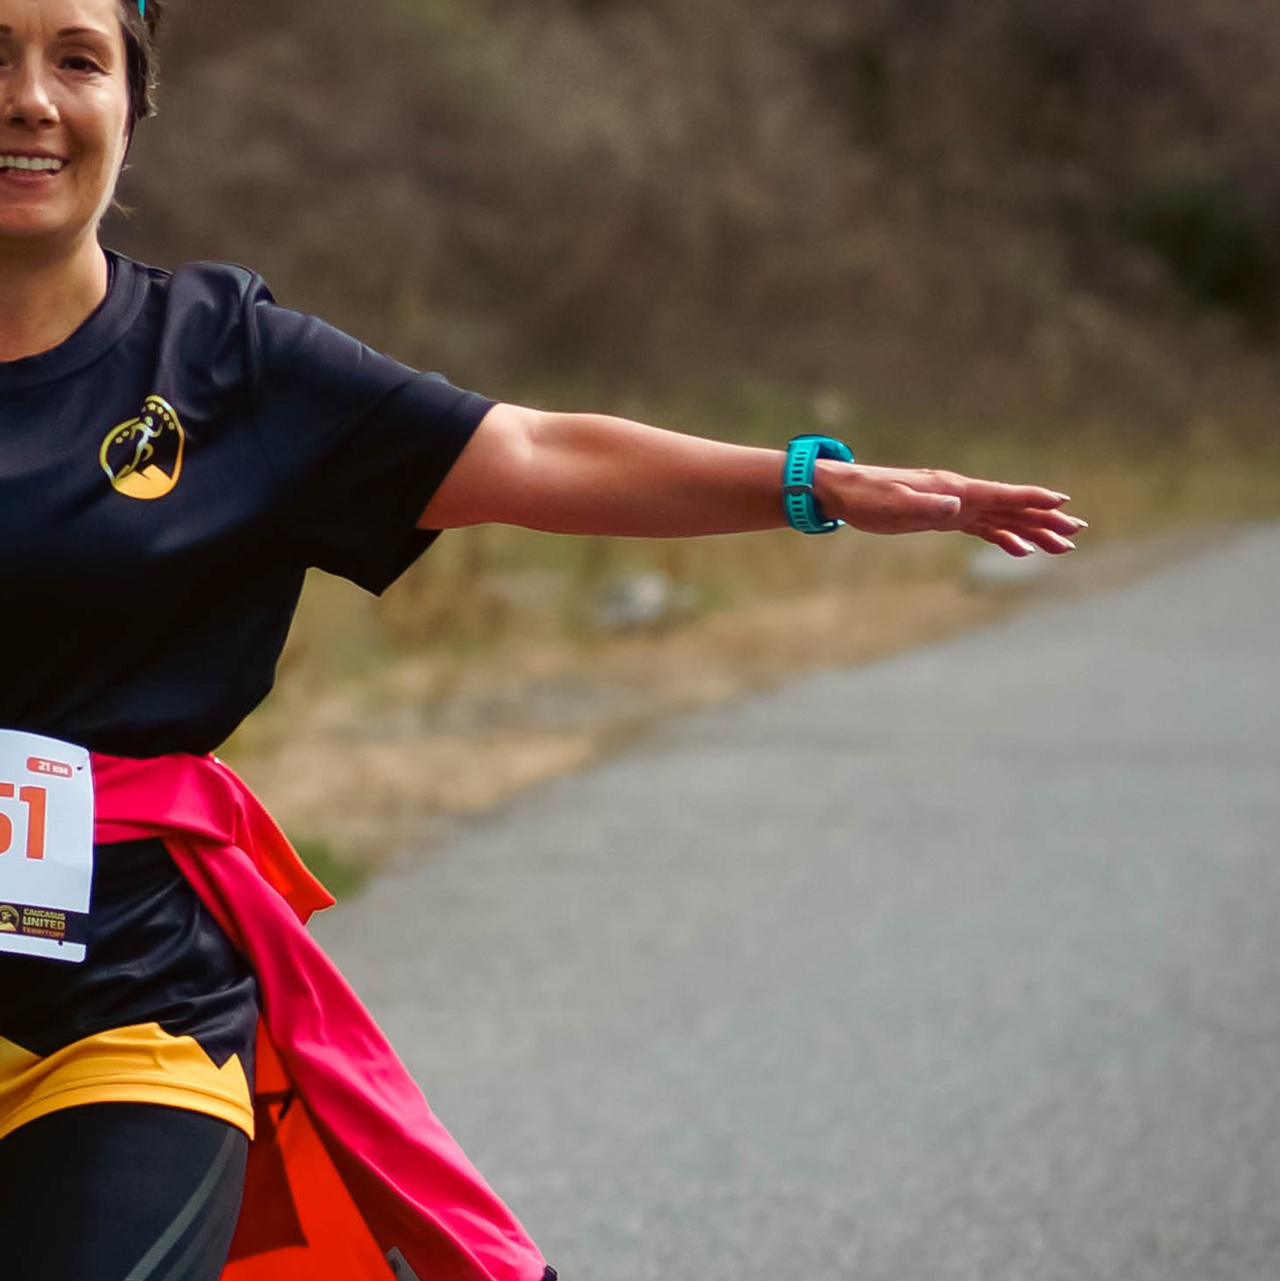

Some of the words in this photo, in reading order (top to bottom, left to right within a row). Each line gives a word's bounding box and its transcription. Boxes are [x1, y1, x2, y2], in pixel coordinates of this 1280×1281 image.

[38, 761, 51, 772] 21
[23, 908, 66, 921] CAUCASUS
[23, 916, 66, 930] UNITED
